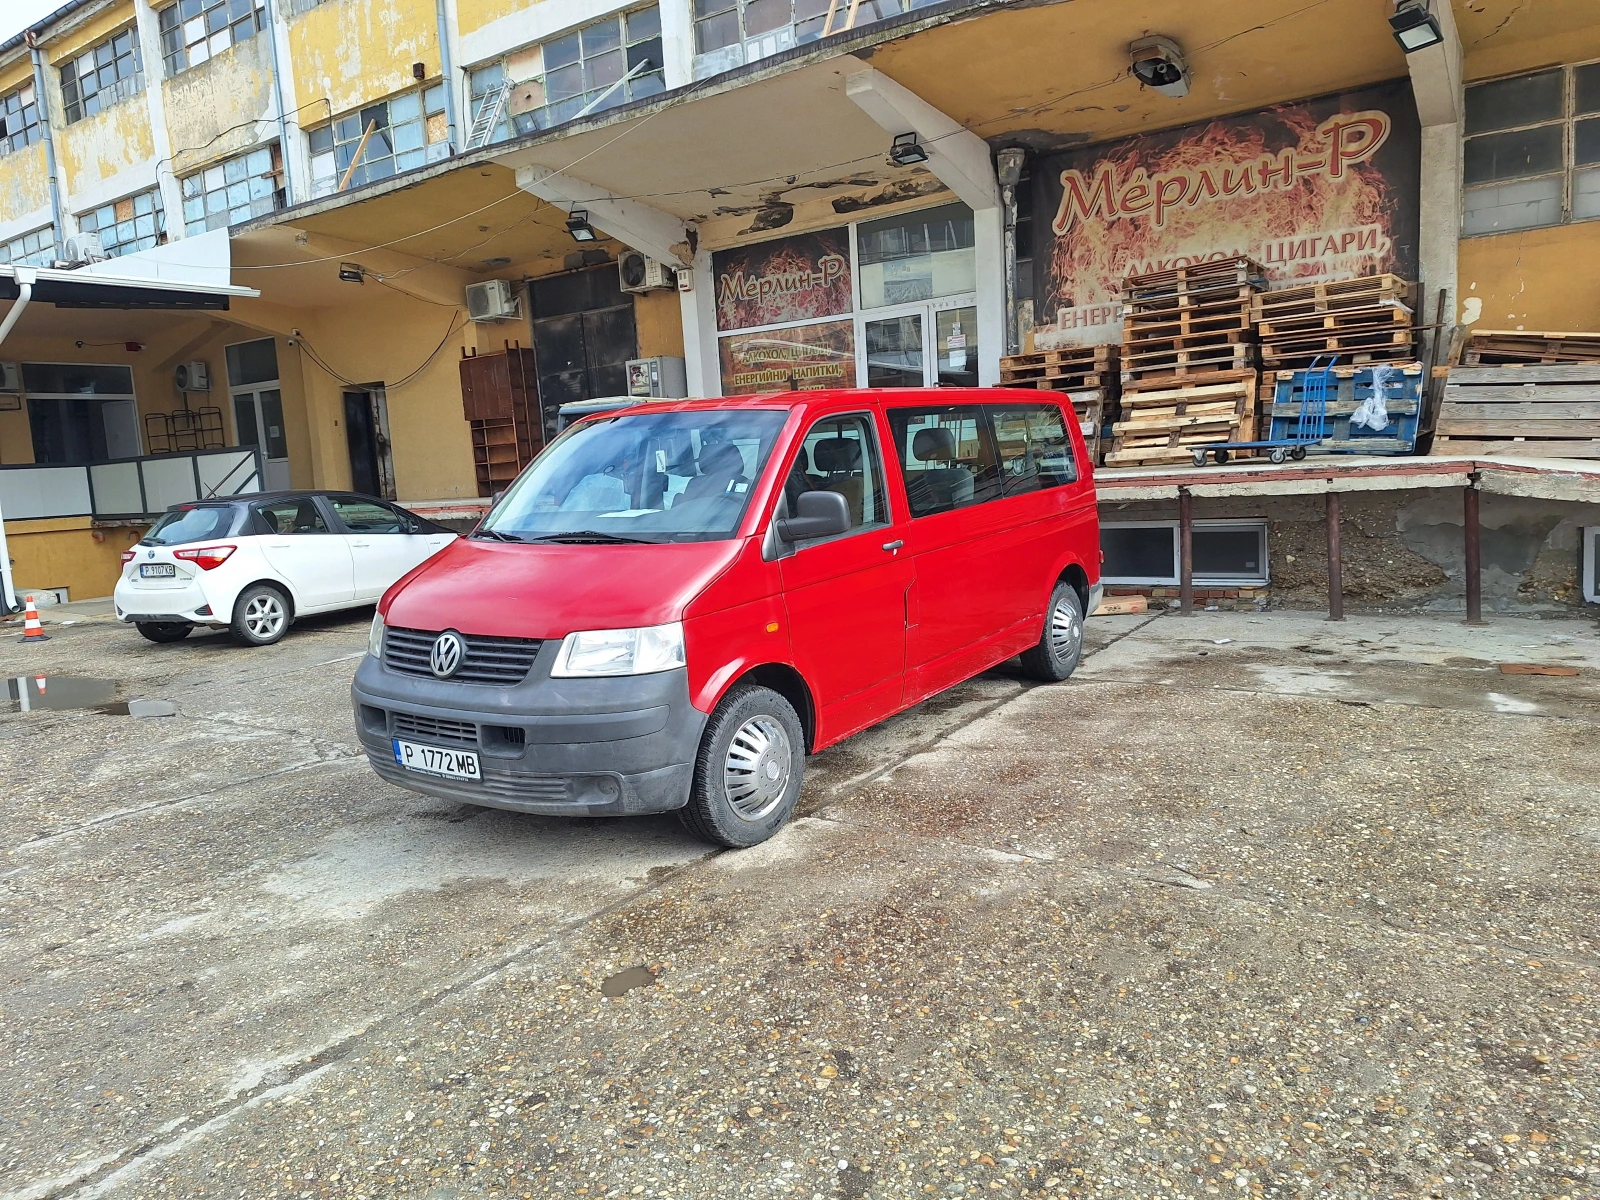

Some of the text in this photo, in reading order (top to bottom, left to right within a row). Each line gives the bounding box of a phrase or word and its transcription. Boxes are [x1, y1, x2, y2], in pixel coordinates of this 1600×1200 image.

[1266, 229, 1386, 266] ЦИГАРИ,
[1061, 304, 1122, 329] ЕНЕРГ
[735, 364, 841, 385] ЕНЕРГИЙНИ НАПИТКИ,
